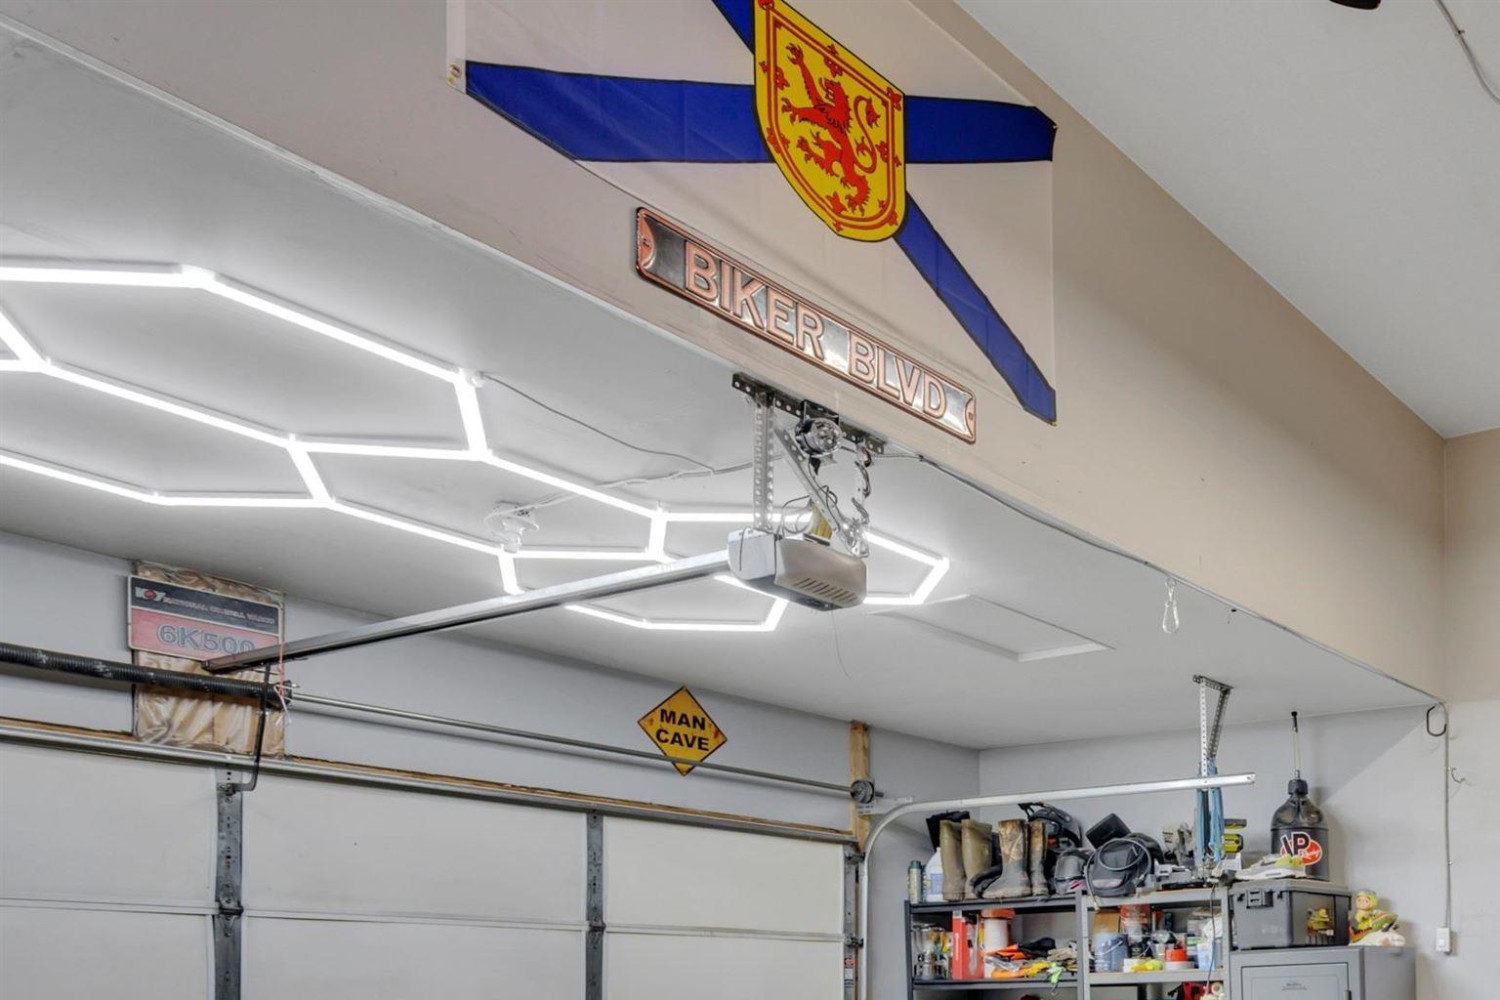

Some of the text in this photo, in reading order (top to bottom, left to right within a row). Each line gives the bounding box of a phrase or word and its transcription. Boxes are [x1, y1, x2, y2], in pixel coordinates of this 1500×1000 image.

[684, 240, 947, 420] BIKER BLVD
[660, 708, 706, 731] MAN
[656, 728, 709, 751] CAVE
